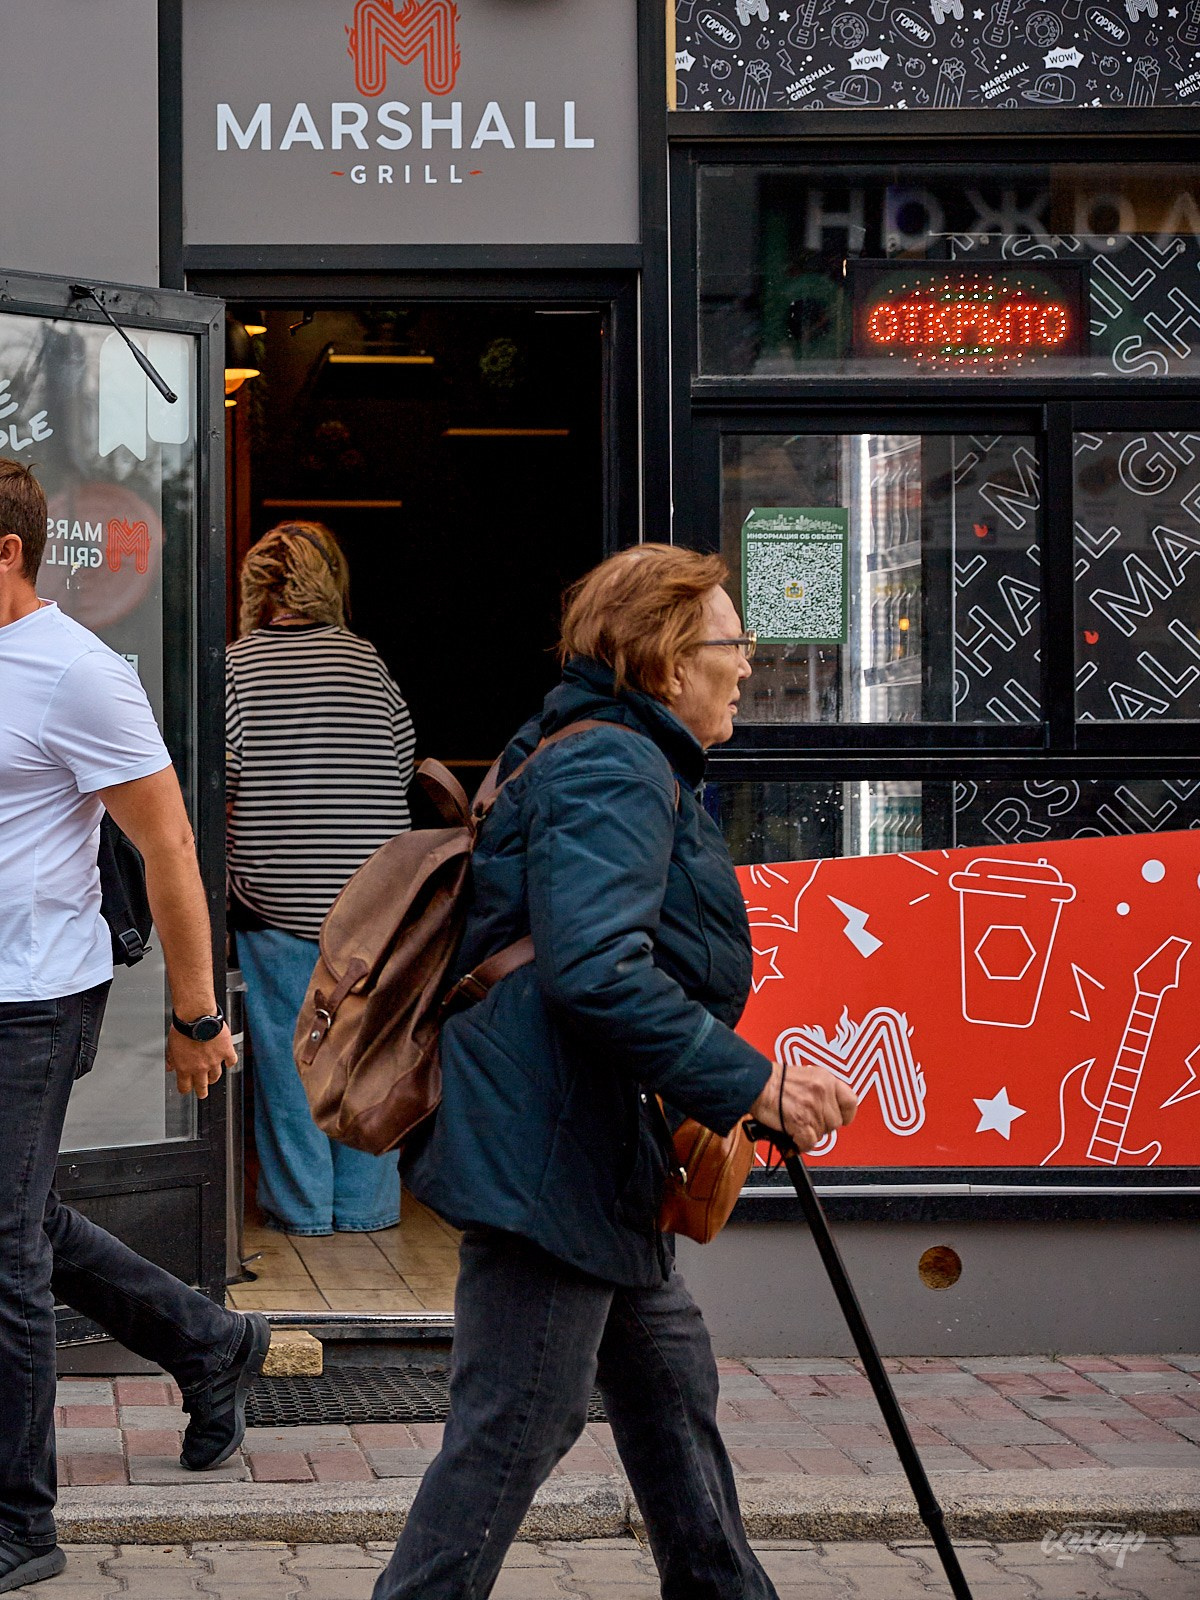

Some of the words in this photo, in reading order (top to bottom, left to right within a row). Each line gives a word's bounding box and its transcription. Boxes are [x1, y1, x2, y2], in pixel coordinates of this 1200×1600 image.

[855, 54, 883, 66] WOW!
[1049, 52, 1077, 65] WOW!
[785, 64, 835, 94] MARSHALL
[980, 62, 1030, 92] MARSHALL
[790, 84, 817, 102] GRILL
[984, 82, 1011, 100] GRILL
[216, 101, 596, 151] MARSHALL
[350, 164, 463, 184] GRILL
[867, 301, 1069, 345] ОТКРЫТО
